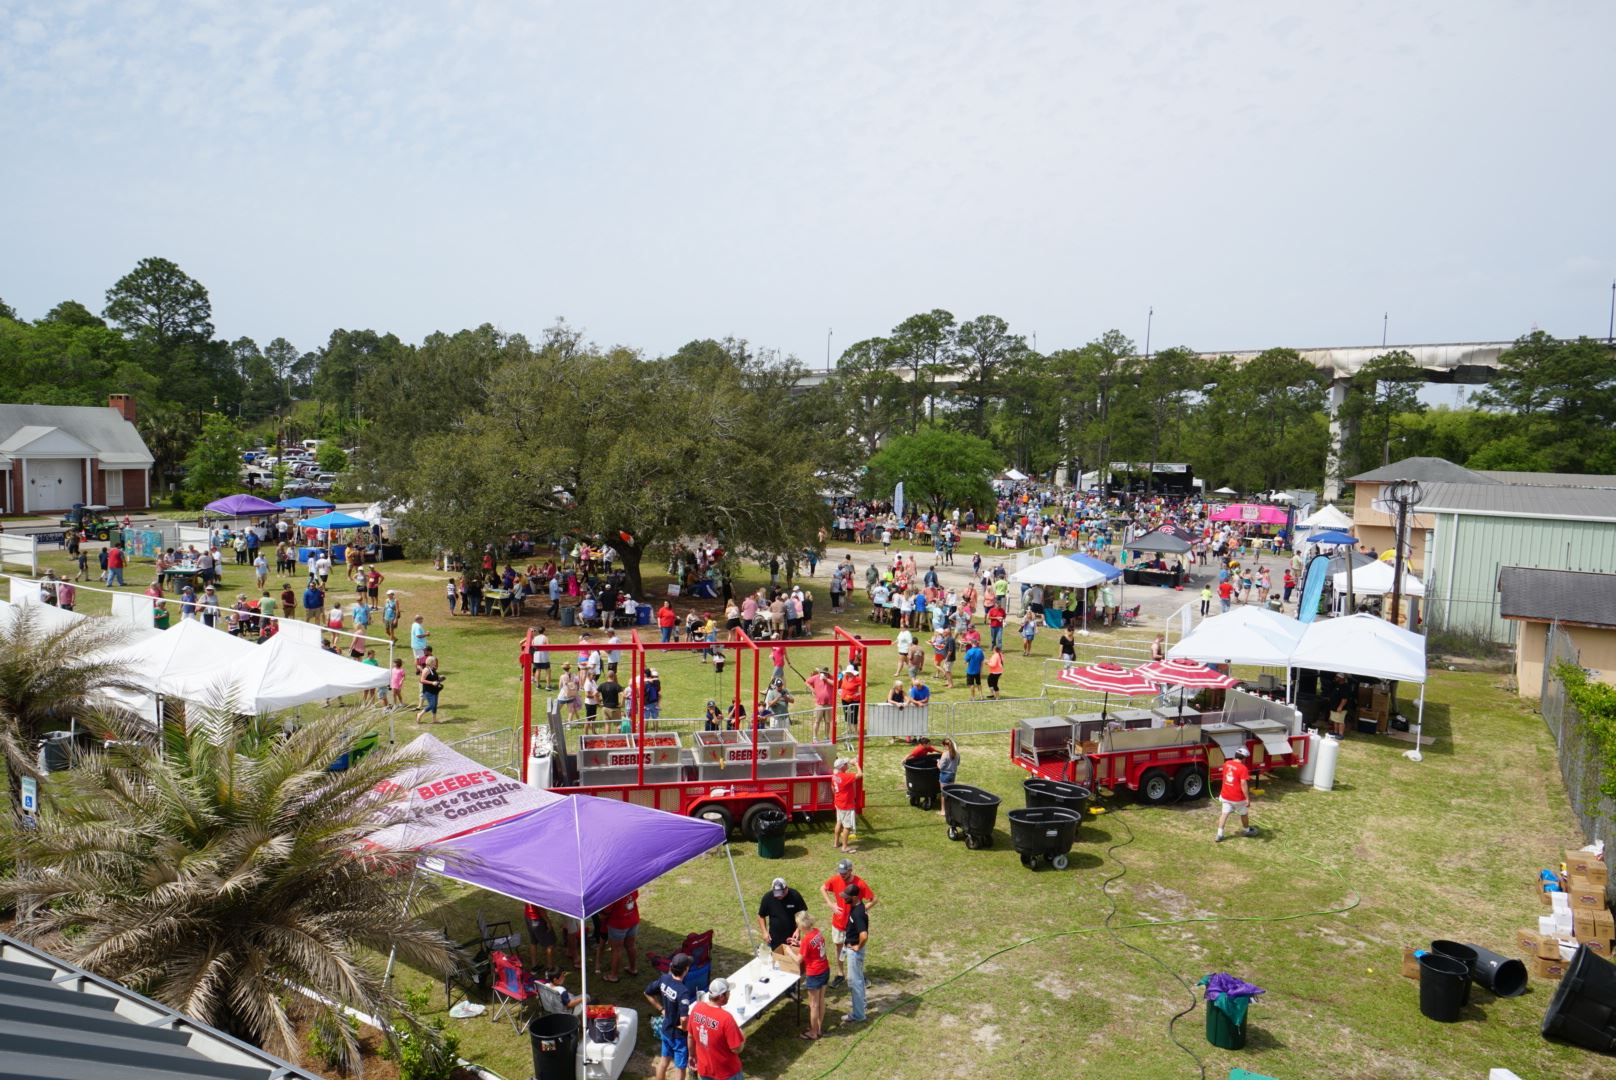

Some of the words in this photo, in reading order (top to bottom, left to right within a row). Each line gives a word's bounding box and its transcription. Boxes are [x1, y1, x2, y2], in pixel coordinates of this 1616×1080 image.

[417, 770, 497, 801] BEEBE'S
[457, 782, 521, 802] Termite
[444, 795, 509, 819] Control
